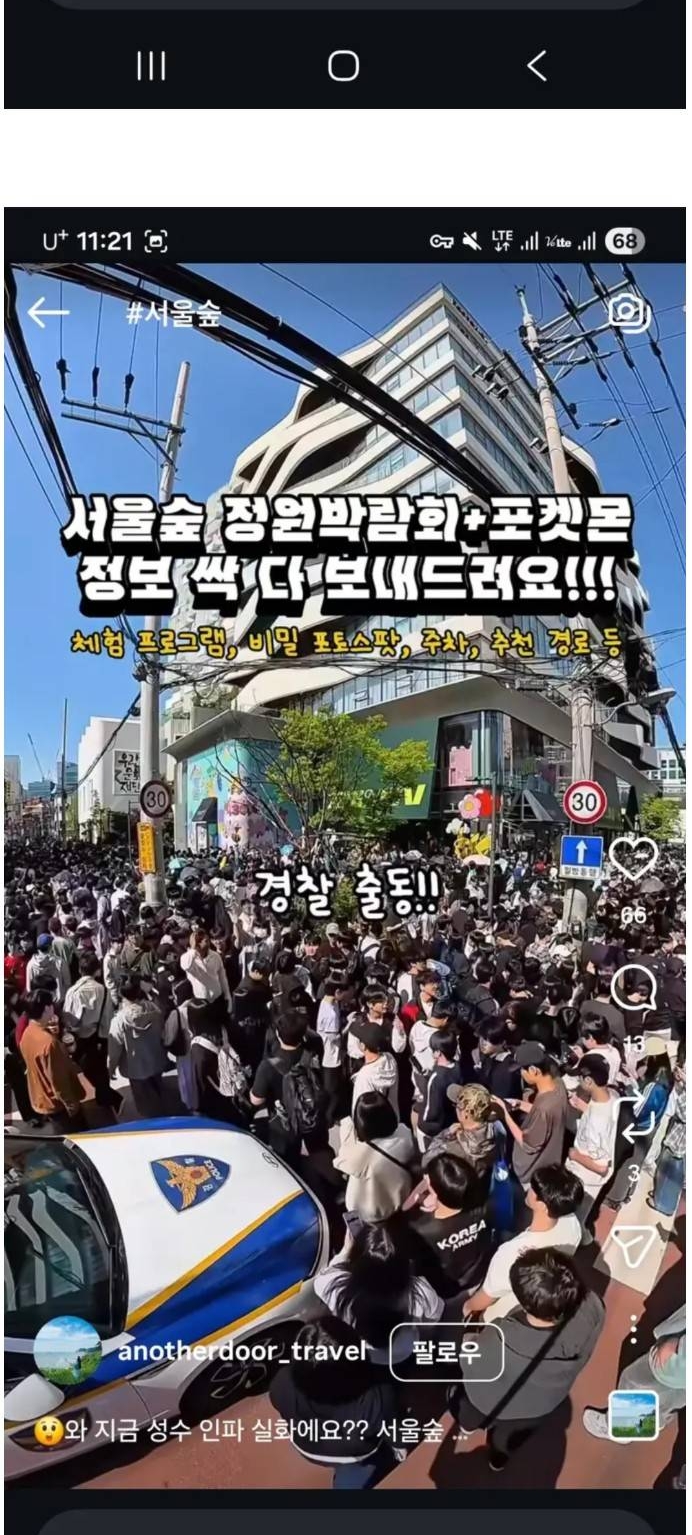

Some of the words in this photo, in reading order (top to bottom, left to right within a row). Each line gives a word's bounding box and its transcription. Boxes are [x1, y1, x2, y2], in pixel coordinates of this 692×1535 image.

[146, 791, 166, 808] 30
[572, 792, 598, 812] 30
[437, 1219, 486, 1250] KOREA
[452, 1233, 478, 1252] ARMY
